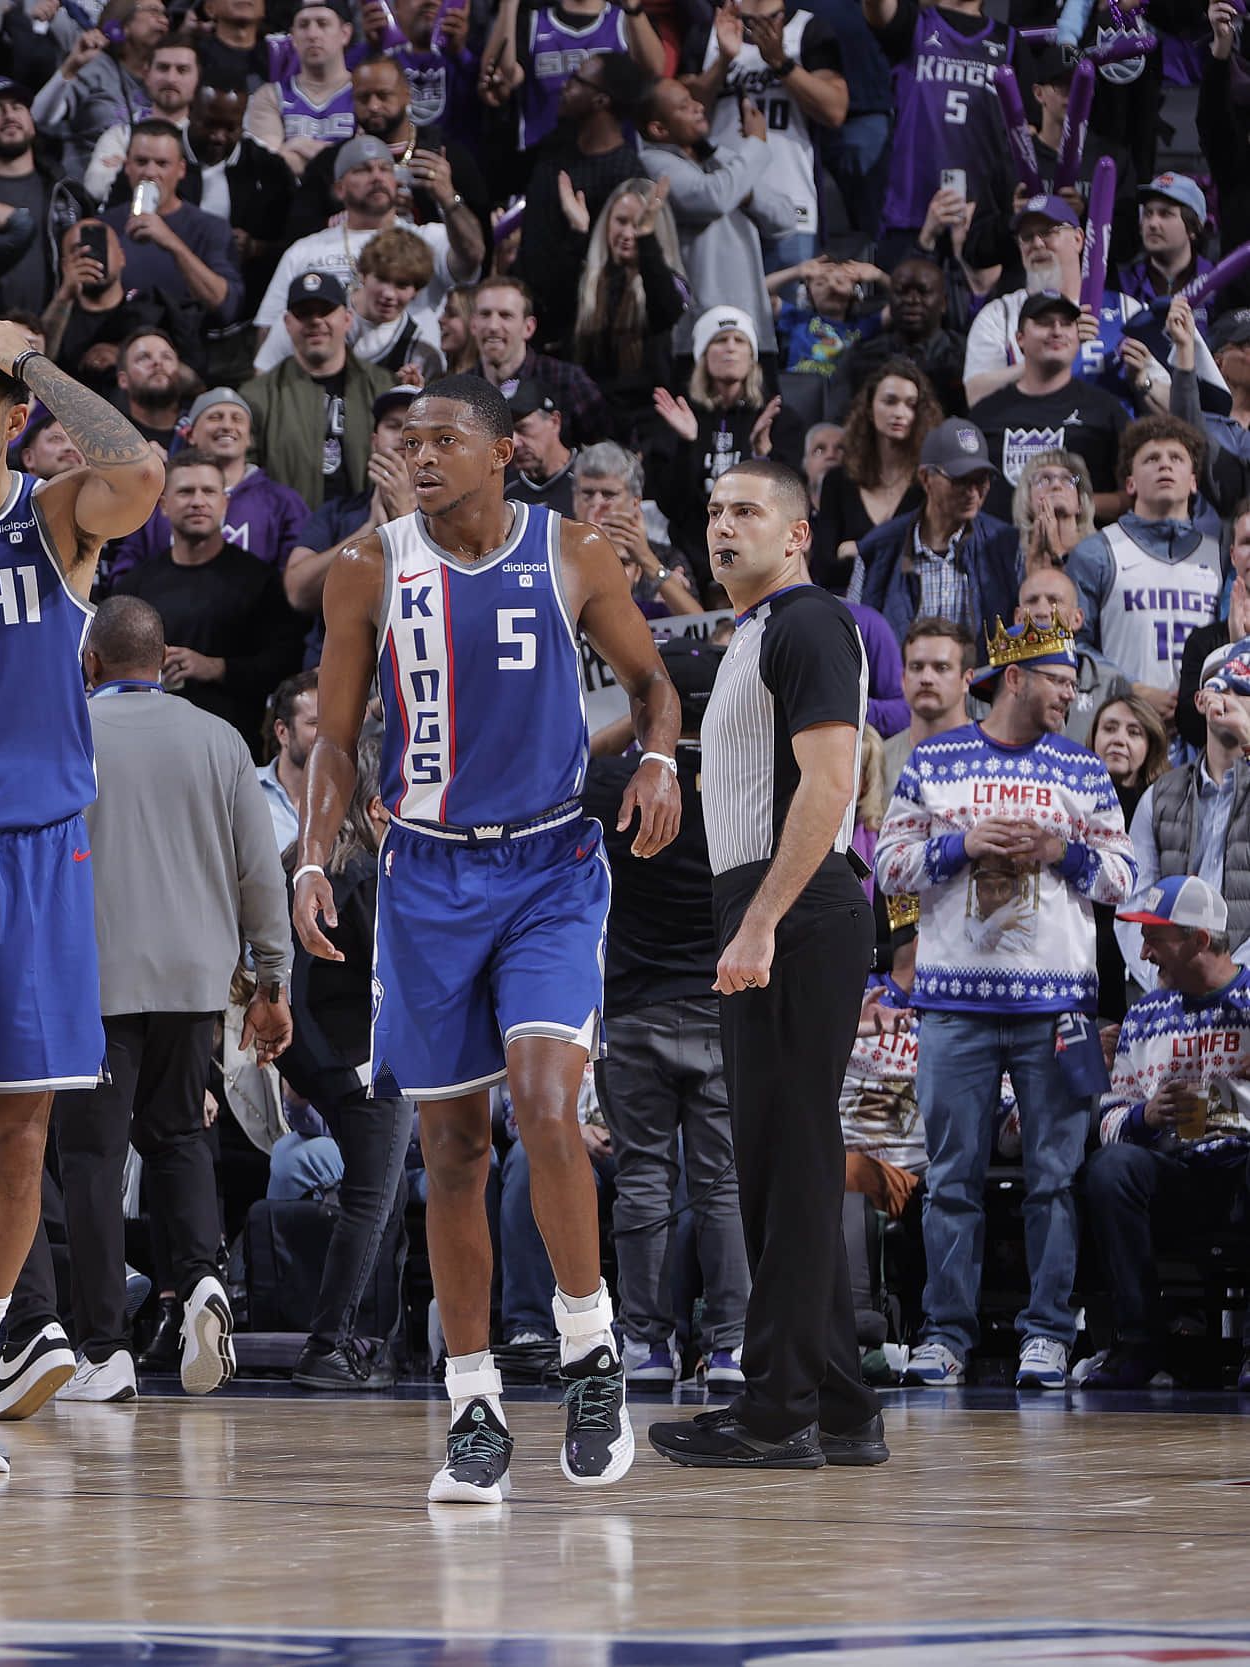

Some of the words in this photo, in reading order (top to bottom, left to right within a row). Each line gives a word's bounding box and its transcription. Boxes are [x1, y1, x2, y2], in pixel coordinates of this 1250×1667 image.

[944, 89, 970, 125] 5
[1081, 340, 1104, 375] 5
[502, 562, 548, 574] dialpad
[1124, 588, 1217, 613] KINGS
[496, 608, 538, 670] 5
[1154, 621, 1199, 660] 15
[401, 586, 442, 784] KINGS
[973, 782, 1052, 807] LTMFB
[1172, 1031, 1241, 1058] LTMFB
